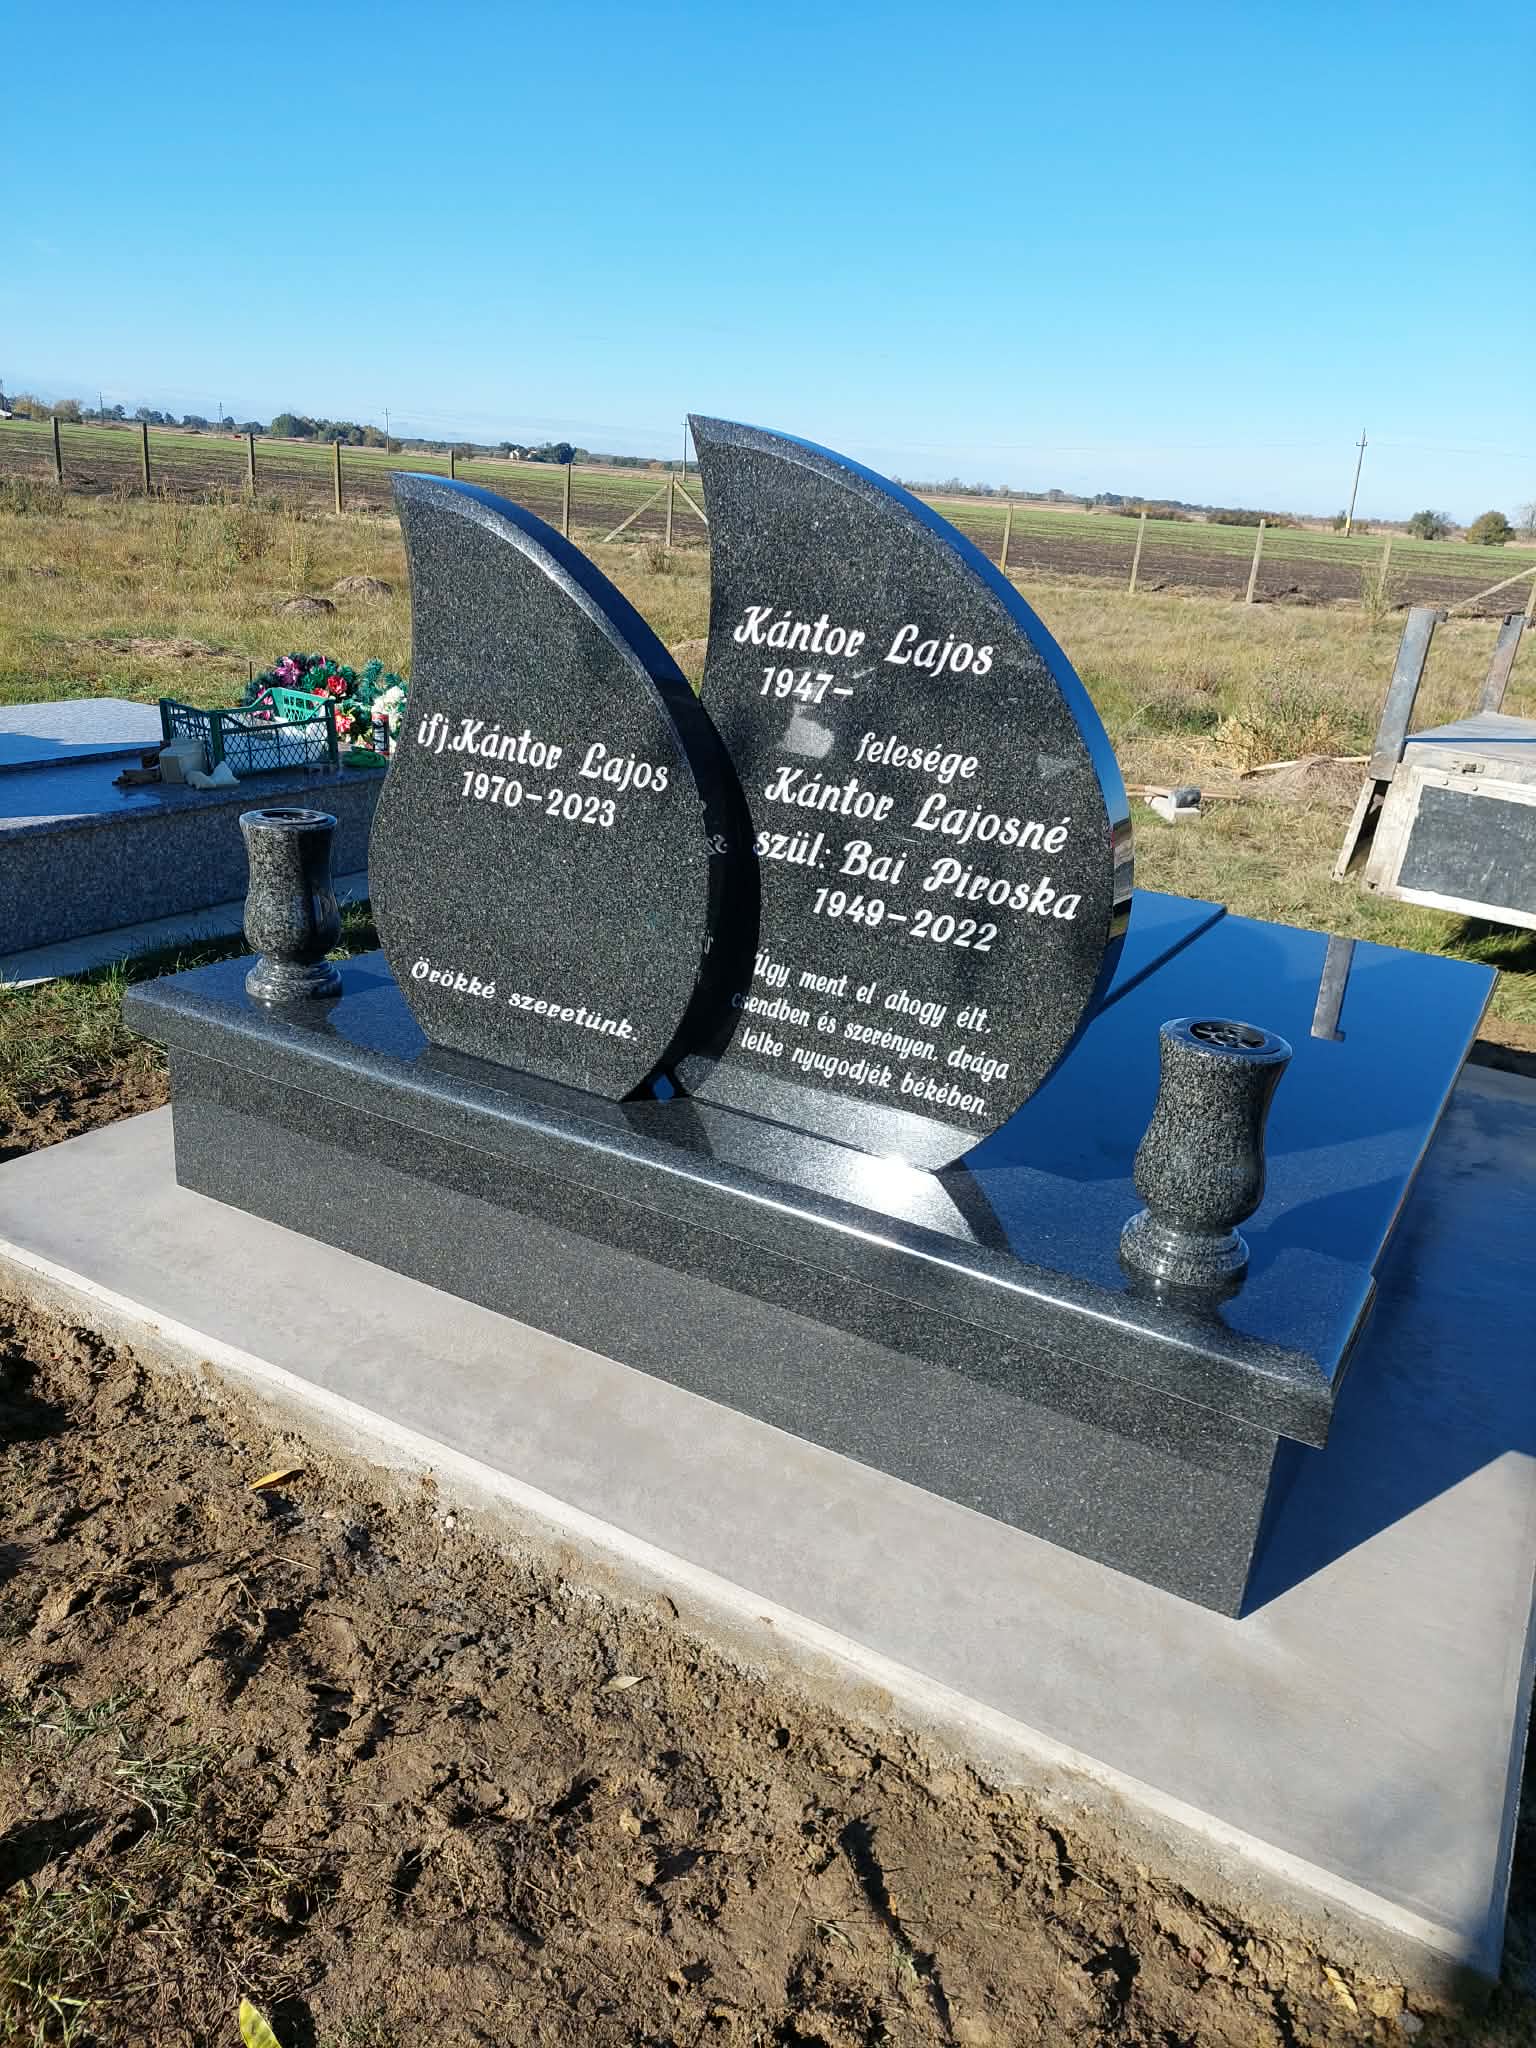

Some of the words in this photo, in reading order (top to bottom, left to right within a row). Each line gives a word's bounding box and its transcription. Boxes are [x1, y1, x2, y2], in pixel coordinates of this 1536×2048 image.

[733, 605, 866, 658] Kántor
[884, 623, 995, 677] Lajos
[579, 742, 669, 792] Lajos
[855, 732, 979, 784] felesége
[461, 771, 616, 827] 1970-2023
[764, 766, 894, 821] Kántor
[912, 793, 1072, 854] Lajosné
[753, 831, 831, 869] szül:
[839, 840, 908, 885] Bai
[923, 857, 1083, 921] Piroska
[813, 887, 999, 952] 1949-2022
[410, 957, 497, 1000] Örökké
[508, 992, 638, 1042] szeretünk.
[799, 971, 848, 997] ment
[856, 982, 877, 1004] el
[885, 990, 947, 1028] ahogy
[741, 1027, 784, 1058] lelke
[792, 1047, 893, 1088] nyugodjék
[901, 1072, 989, 1116] békében.
[817, 1011, 837, 1034] és
[947, 1045, 1010, 1082] drága
